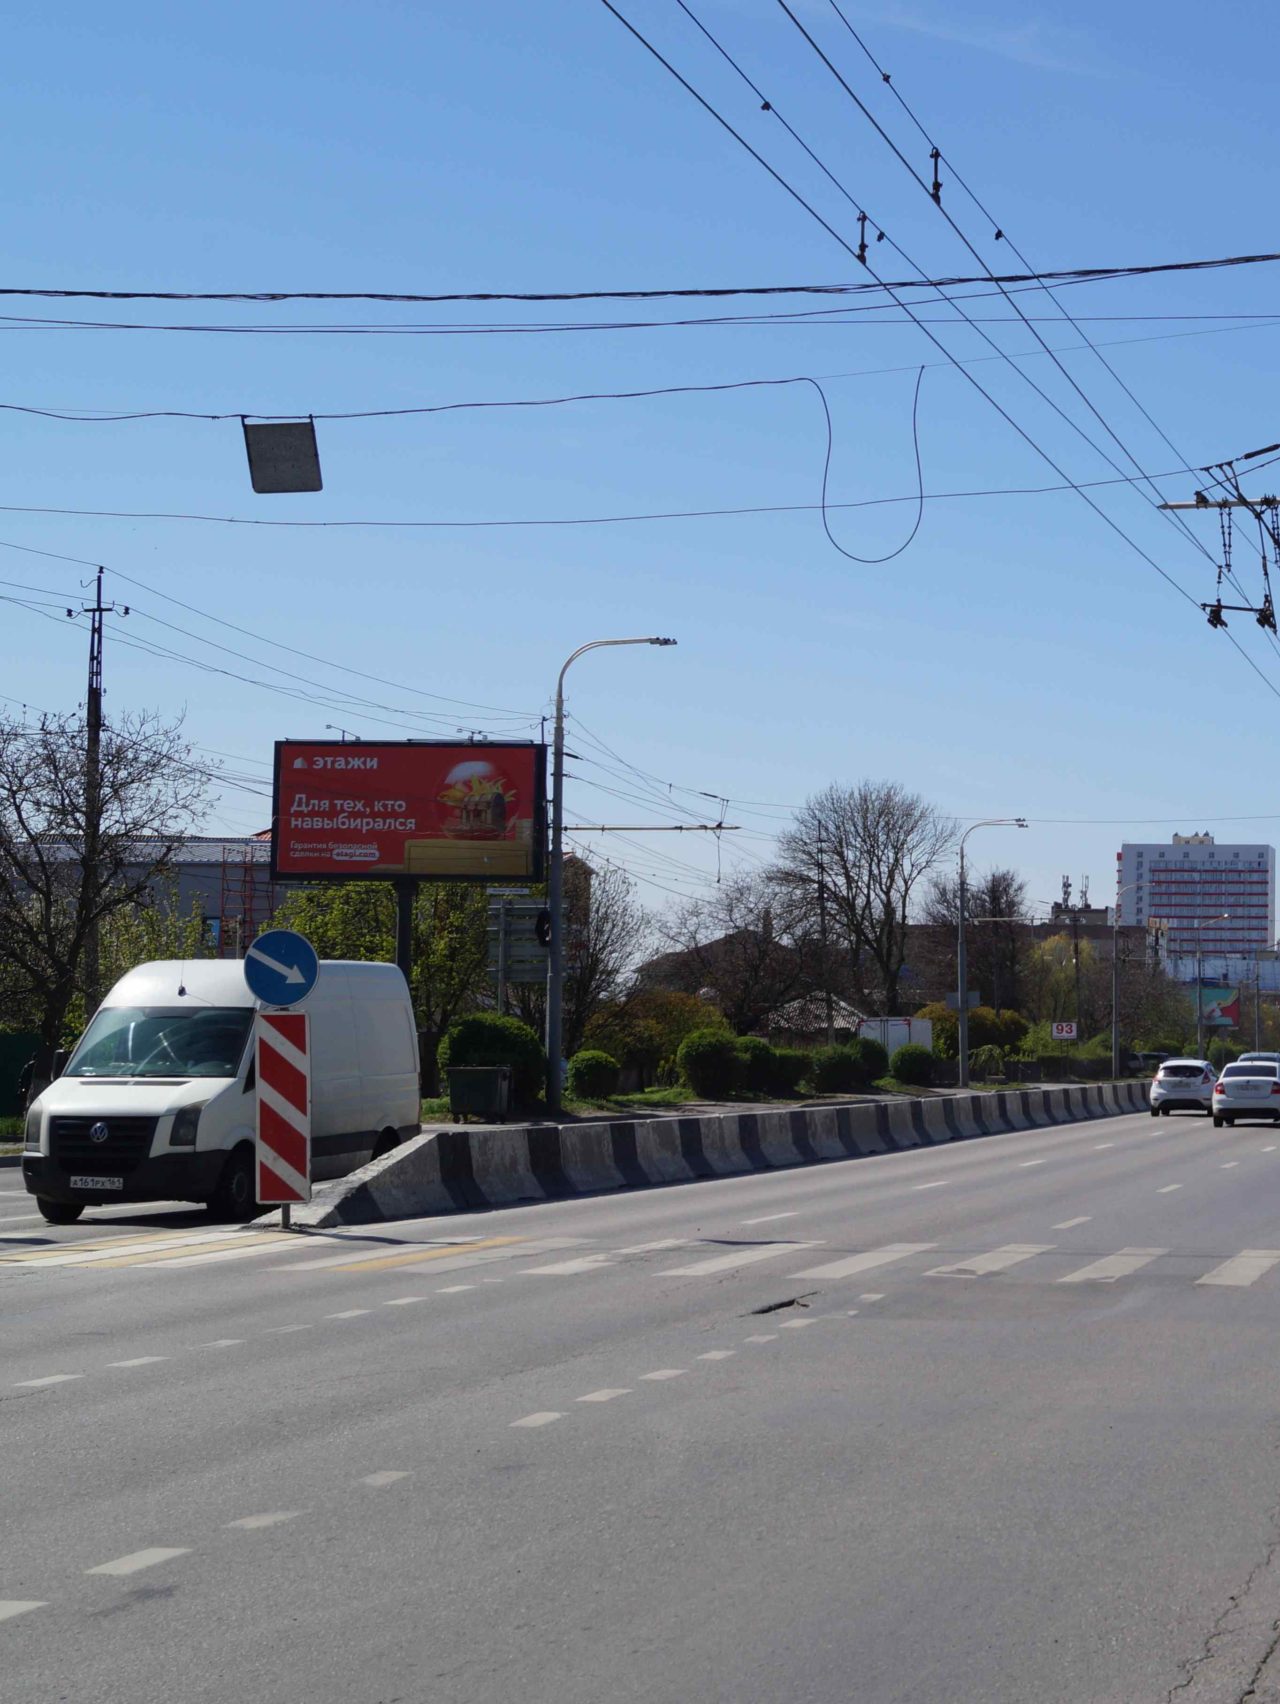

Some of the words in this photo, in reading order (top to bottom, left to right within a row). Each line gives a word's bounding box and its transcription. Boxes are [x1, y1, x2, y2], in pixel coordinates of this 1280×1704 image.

[312, 757, 378, 770] этажи
[290, 794, 329, 814] Для
[334, 800, 370, 815] тех,
[375, 800, 406, 813] кто
[290, 813, 416, 834] навыбирался
[290, 840, 327, 852] Гарантия
[328, 840, 378, 852] безопасной
[1056, 1024, 1073, 1034] 93
